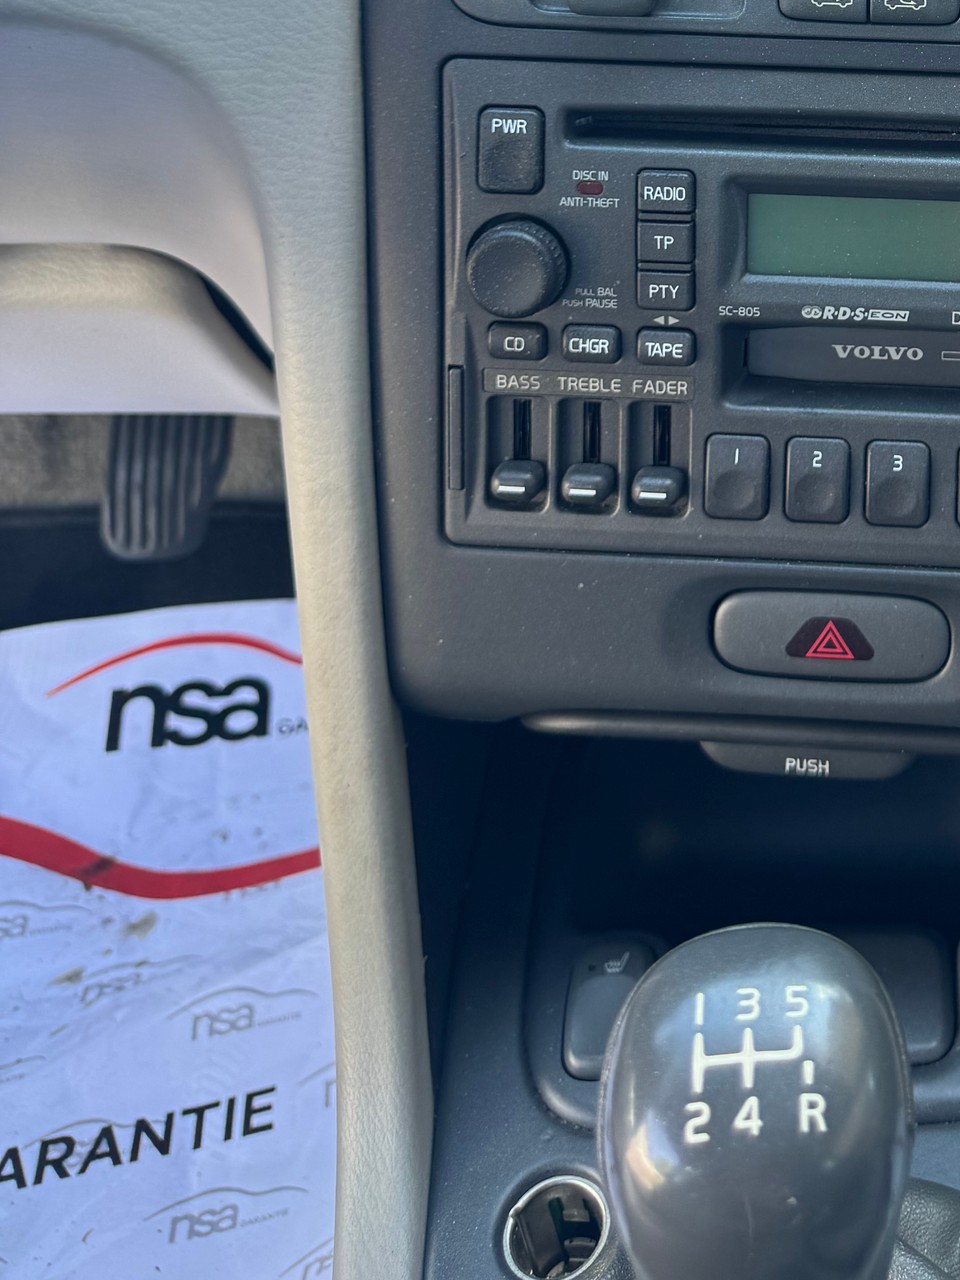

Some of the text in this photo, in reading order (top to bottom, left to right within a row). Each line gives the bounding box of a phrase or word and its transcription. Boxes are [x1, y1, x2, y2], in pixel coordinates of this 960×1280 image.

[491, 119, 527, 135] PWR
[572, 170, 609, 181] DISC IN
[559, 196, 621, 208] ANTI-THEFT
[643, 185, 687, 203] RADIO
[654, 235, 674, 250] TP
[575, 287, 618, 297] PULL BAL
[648, 284, 680, 300] PTY
[562, 297, 618, 309] PUSH PAUSE
[718, 305, 761, 317] SC-805
[504, 336, 525, 352] CD
[568, 337, 609, 355] CHGR
[645, 342, 683, 359] TAPE
[832, 343, 924, 361] VOLVO
[497, 374, 541, 390] BASS
[558, 376, 622, 393] TREBLE
[632, 380, 688, 395] FADER
[812, 450, 823, 468] 2
[892, 453, 903, 472] 3
[105, 675, 272, 753] nsa
[785, 757, 830, 776] PUSH
[736, 988, 760, 1020] 3
[785, 985, 808, 1018] 5
[684, 1093, 828, 1144] 2 4 R
[168, 1204, 239, 1244] nsa
